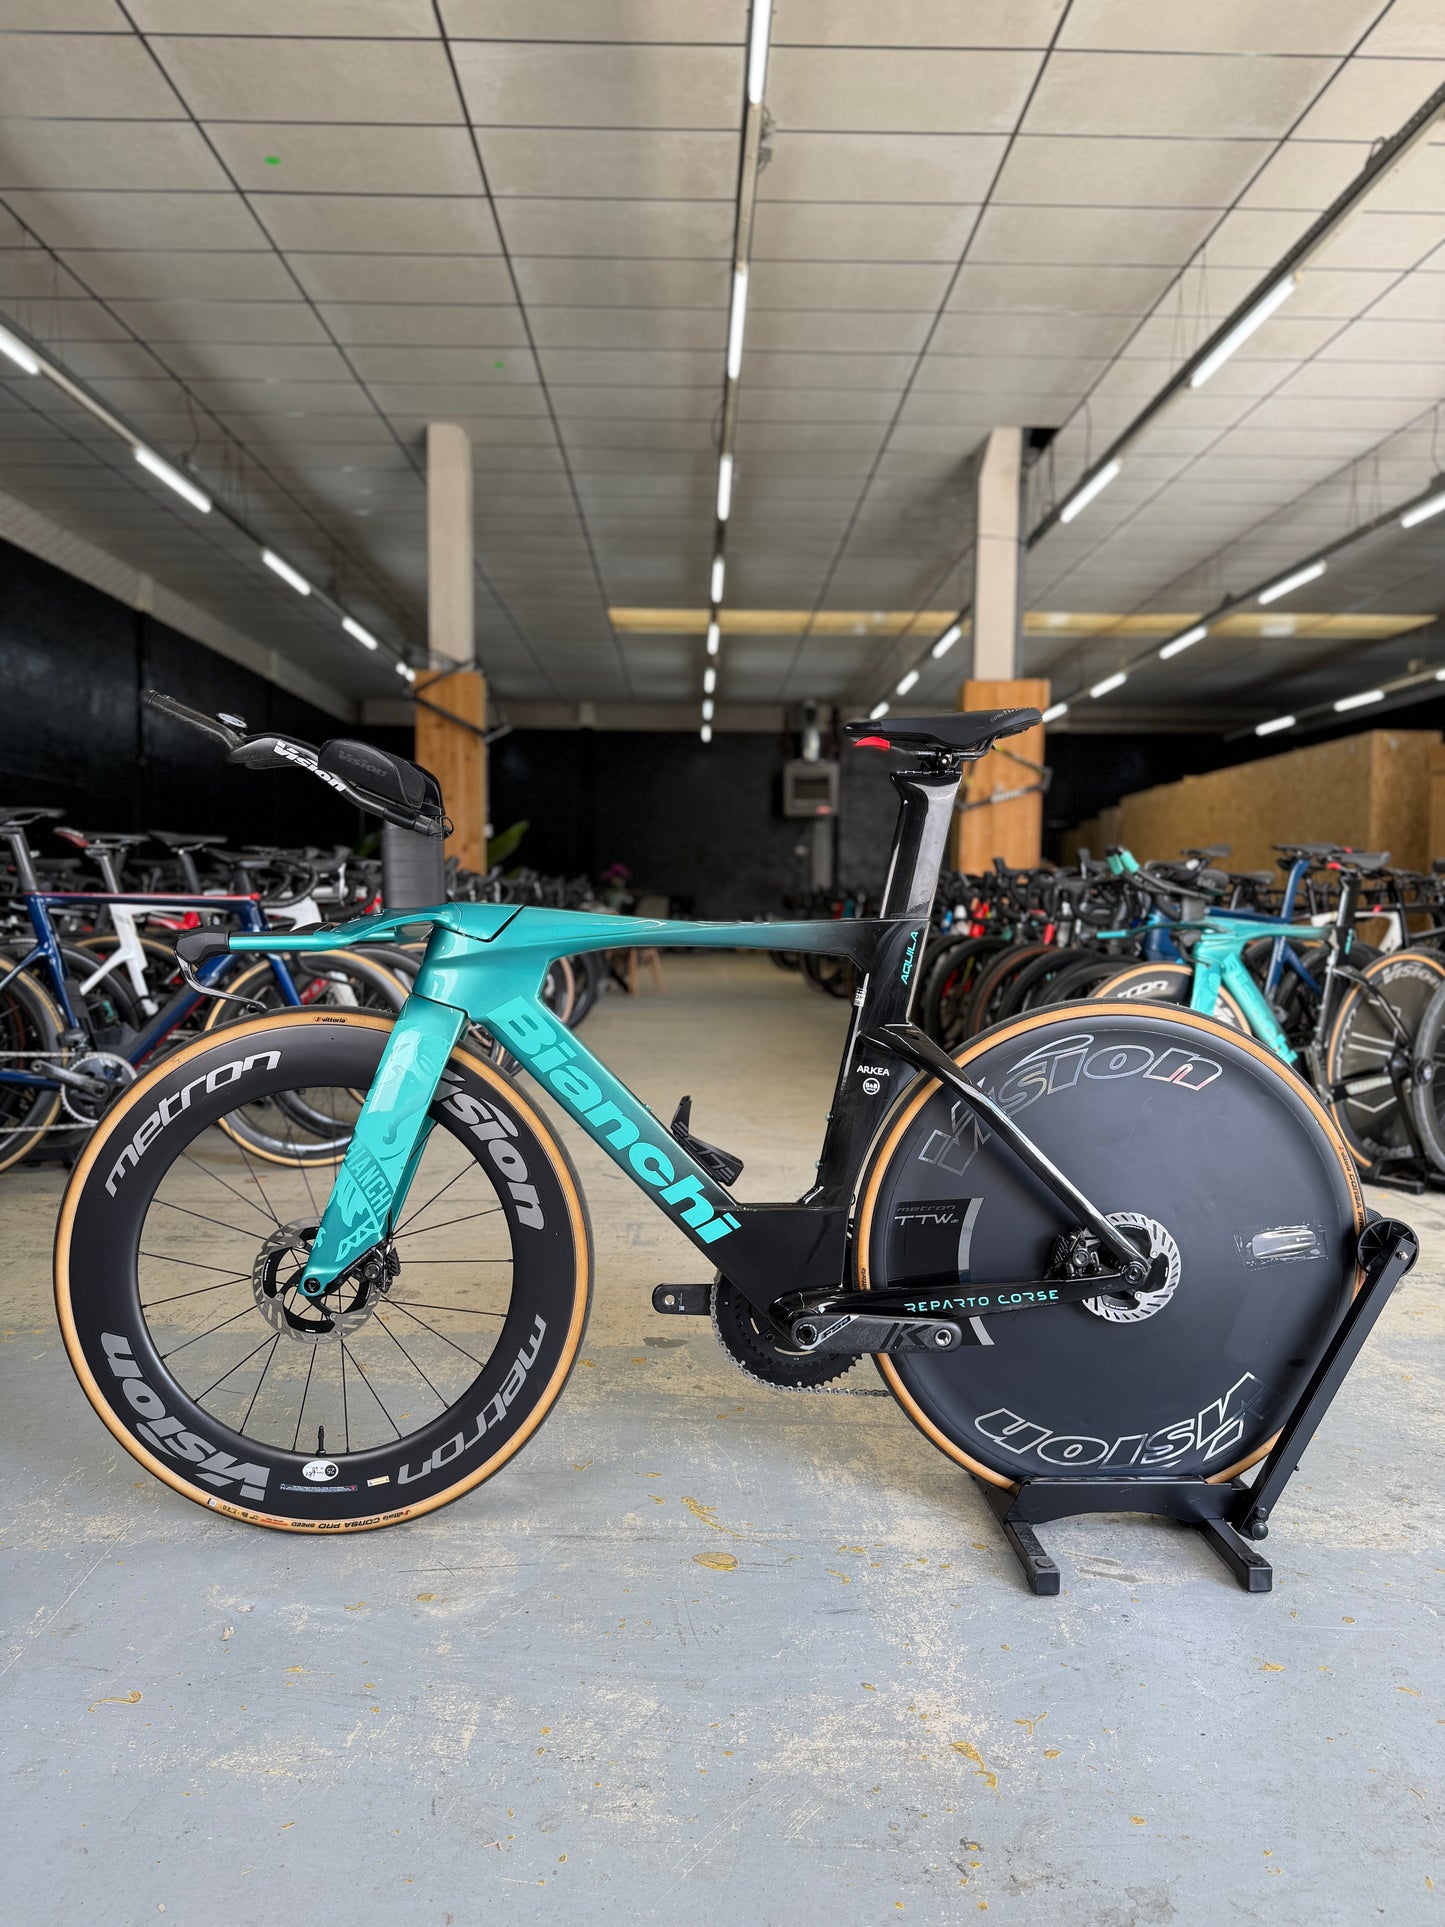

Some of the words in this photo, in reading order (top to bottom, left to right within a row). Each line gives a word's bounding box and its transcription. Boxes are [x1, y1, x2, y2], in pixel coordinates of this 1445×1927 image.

[901, 931, 918, 985] AQUILA
[321, 1016, 346, 1024] vittoria
[856, 1065, 890, 1077] ARKEA
[105, 1049, 282, 1197] metron
[486, 995, 742, 1244] Bianchi
[896, 1204, 956, 1213] metron
[894, 1213, 955, 1226] TTW
[904, 1297, 990, 1313] REPARTO
[997, 1288, 1060, 1306] CORSE
[397, 1314, 547, 1485] metron
[100, 1331, 271, 1502] Vision
[291, 1521, 316, 1529] SPEED
[344, 1517, 380, 1528] CORSA
